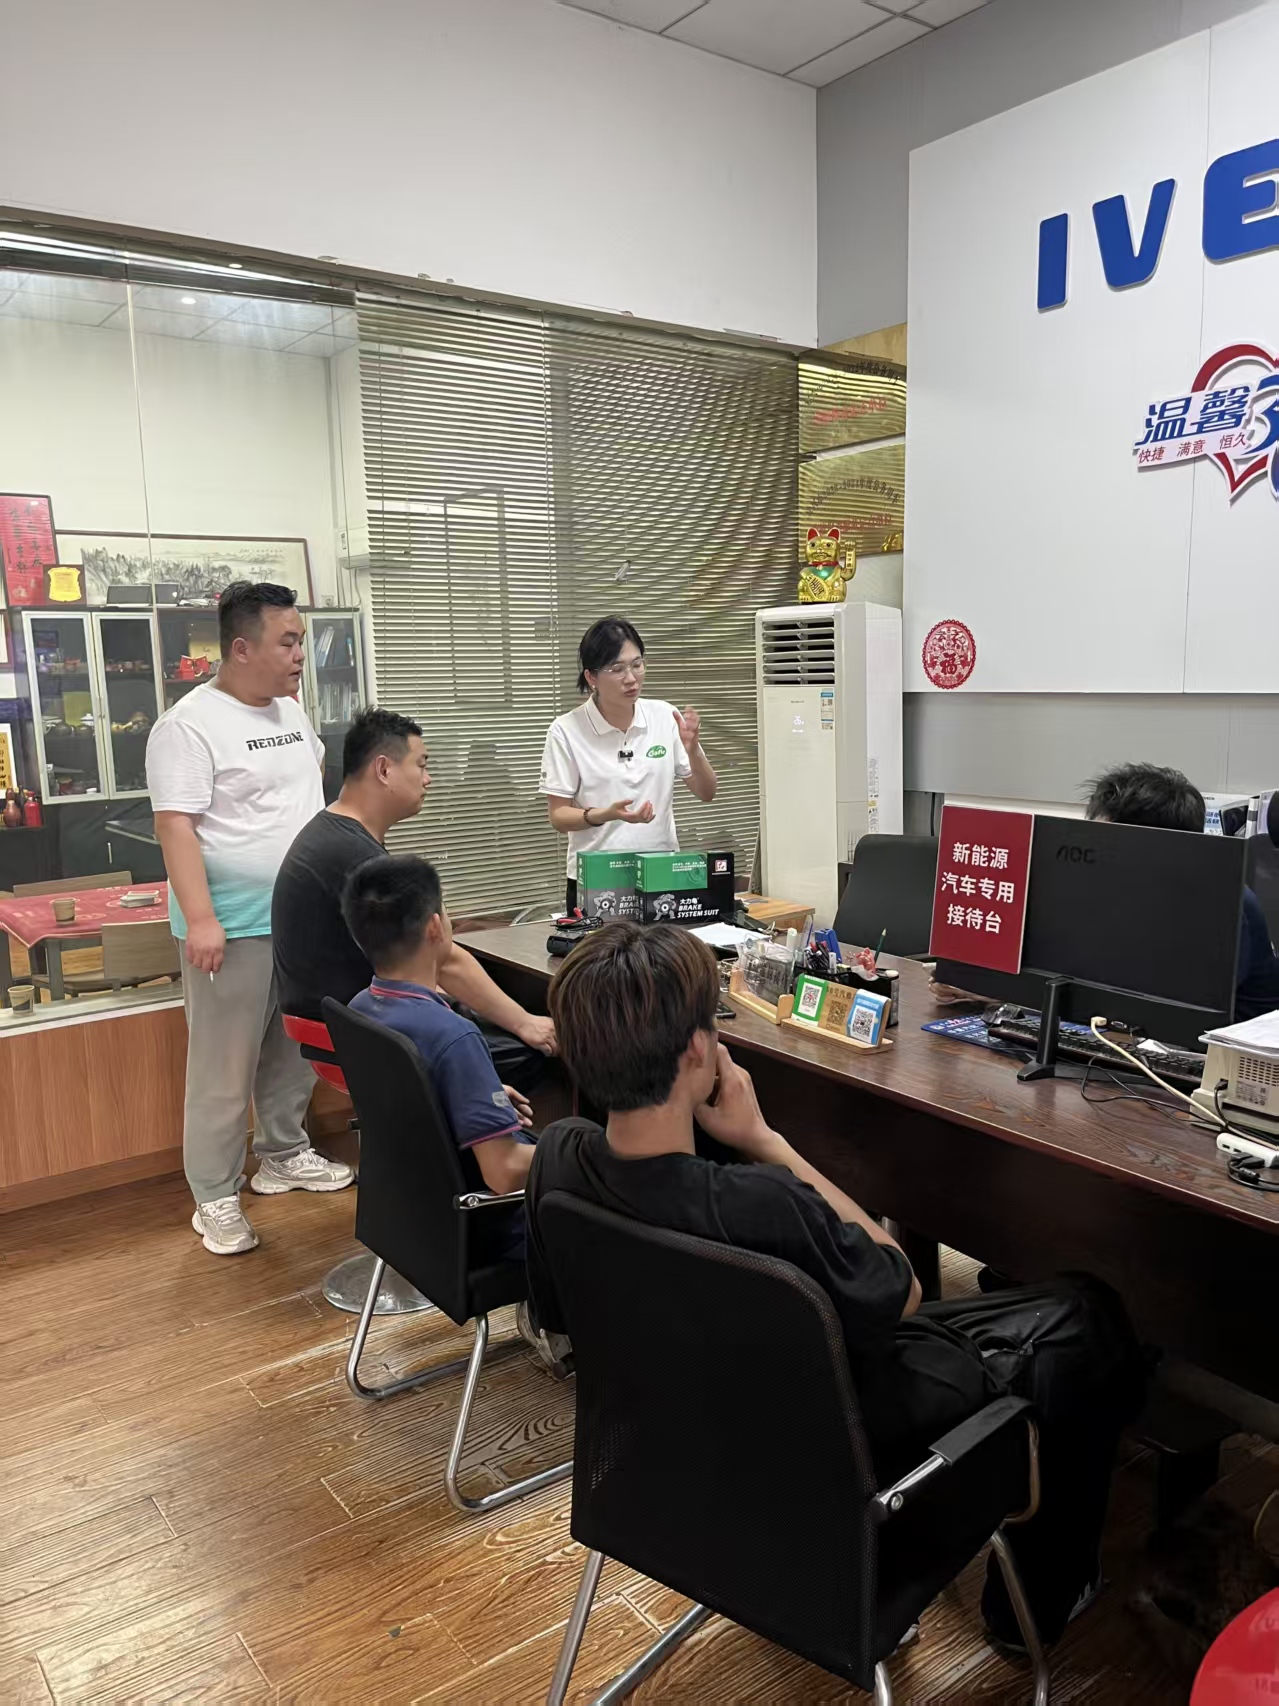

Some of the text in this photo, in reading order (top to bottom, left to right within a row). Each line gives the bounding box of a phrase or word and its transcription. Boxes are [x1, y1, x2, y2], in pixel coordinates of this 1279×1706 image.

[1138, 432, 1247, 464] 快捷 满意 恒久
[952, 841, 1009, 870] 新能源
[941, 872, 1015, 904] 汽车专用
[677, 908, 720, 918] SYSTEM SUIT
[947, 904, 1002, 934] 接待台
